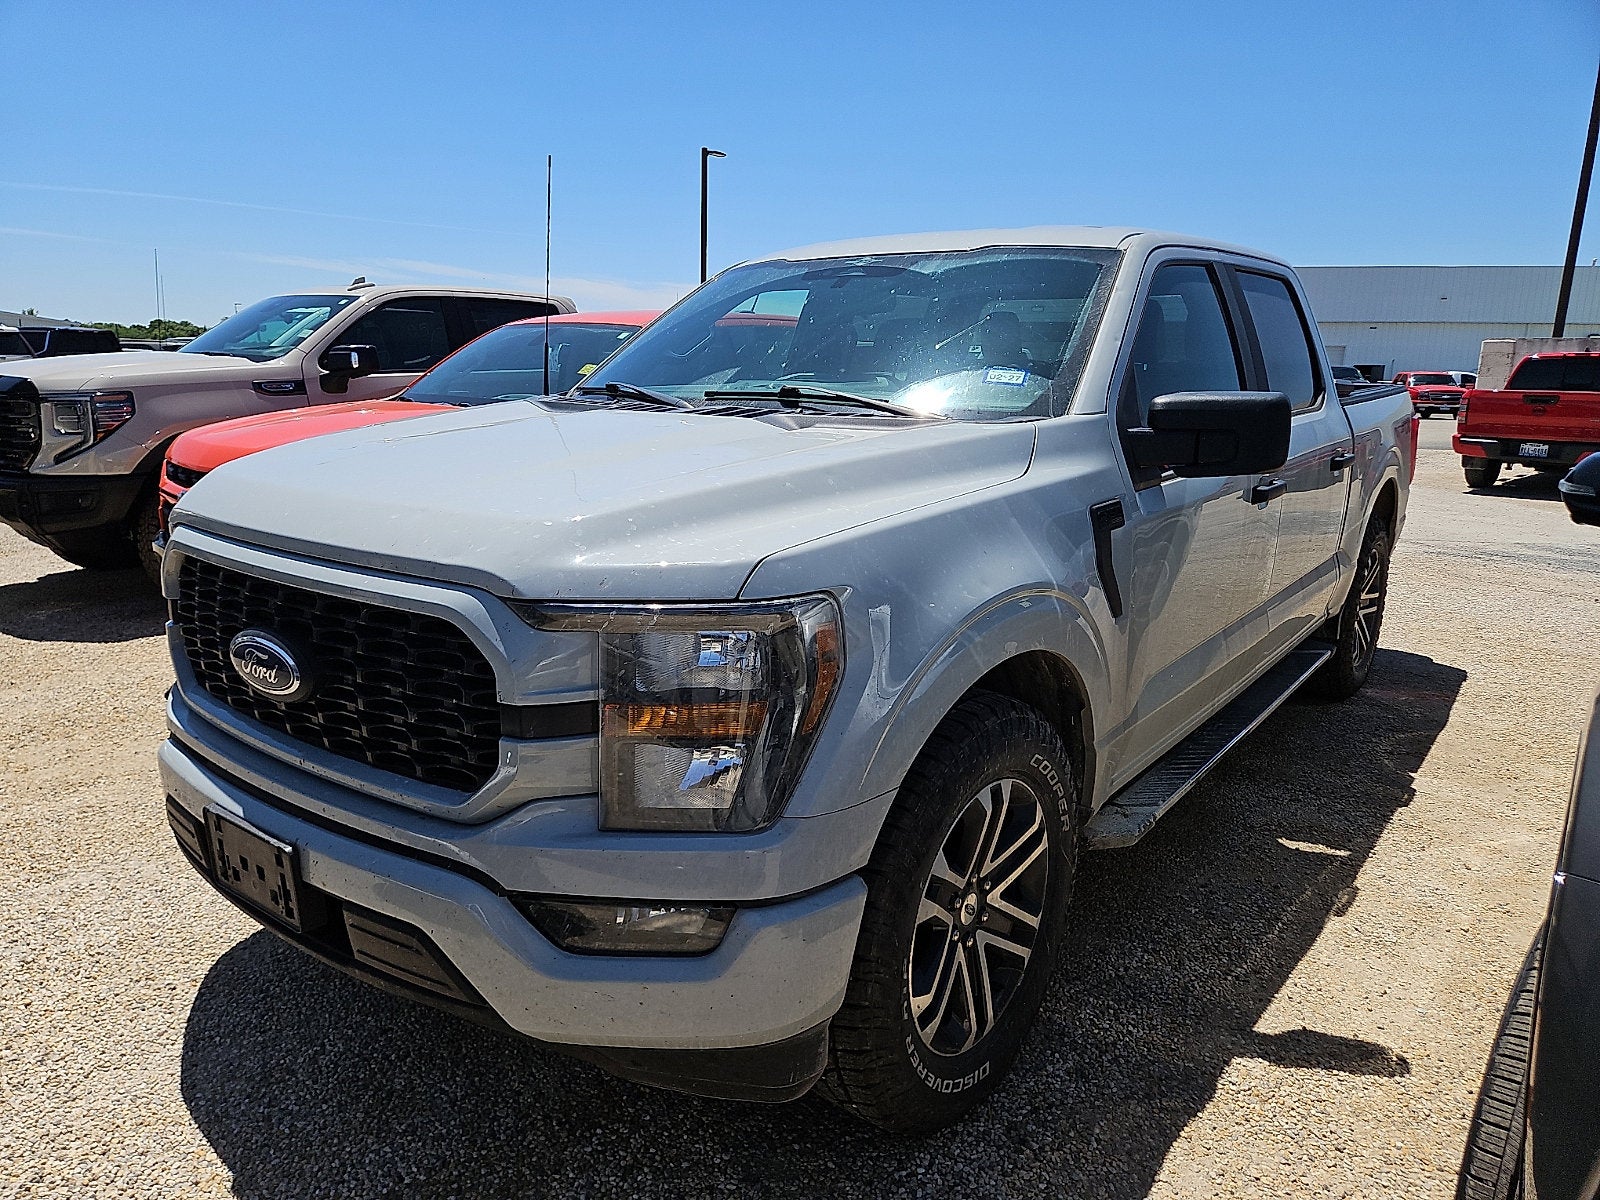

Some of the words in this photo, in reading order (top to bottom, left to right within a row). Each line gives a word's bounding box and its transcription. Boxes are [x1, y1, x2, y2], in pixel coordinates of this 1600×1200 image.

[242, 647, 279, 684] Ford
[1029, 753, 1070, 832] COOPER
[904, 1033, 990, 1094] DISCOVERER
